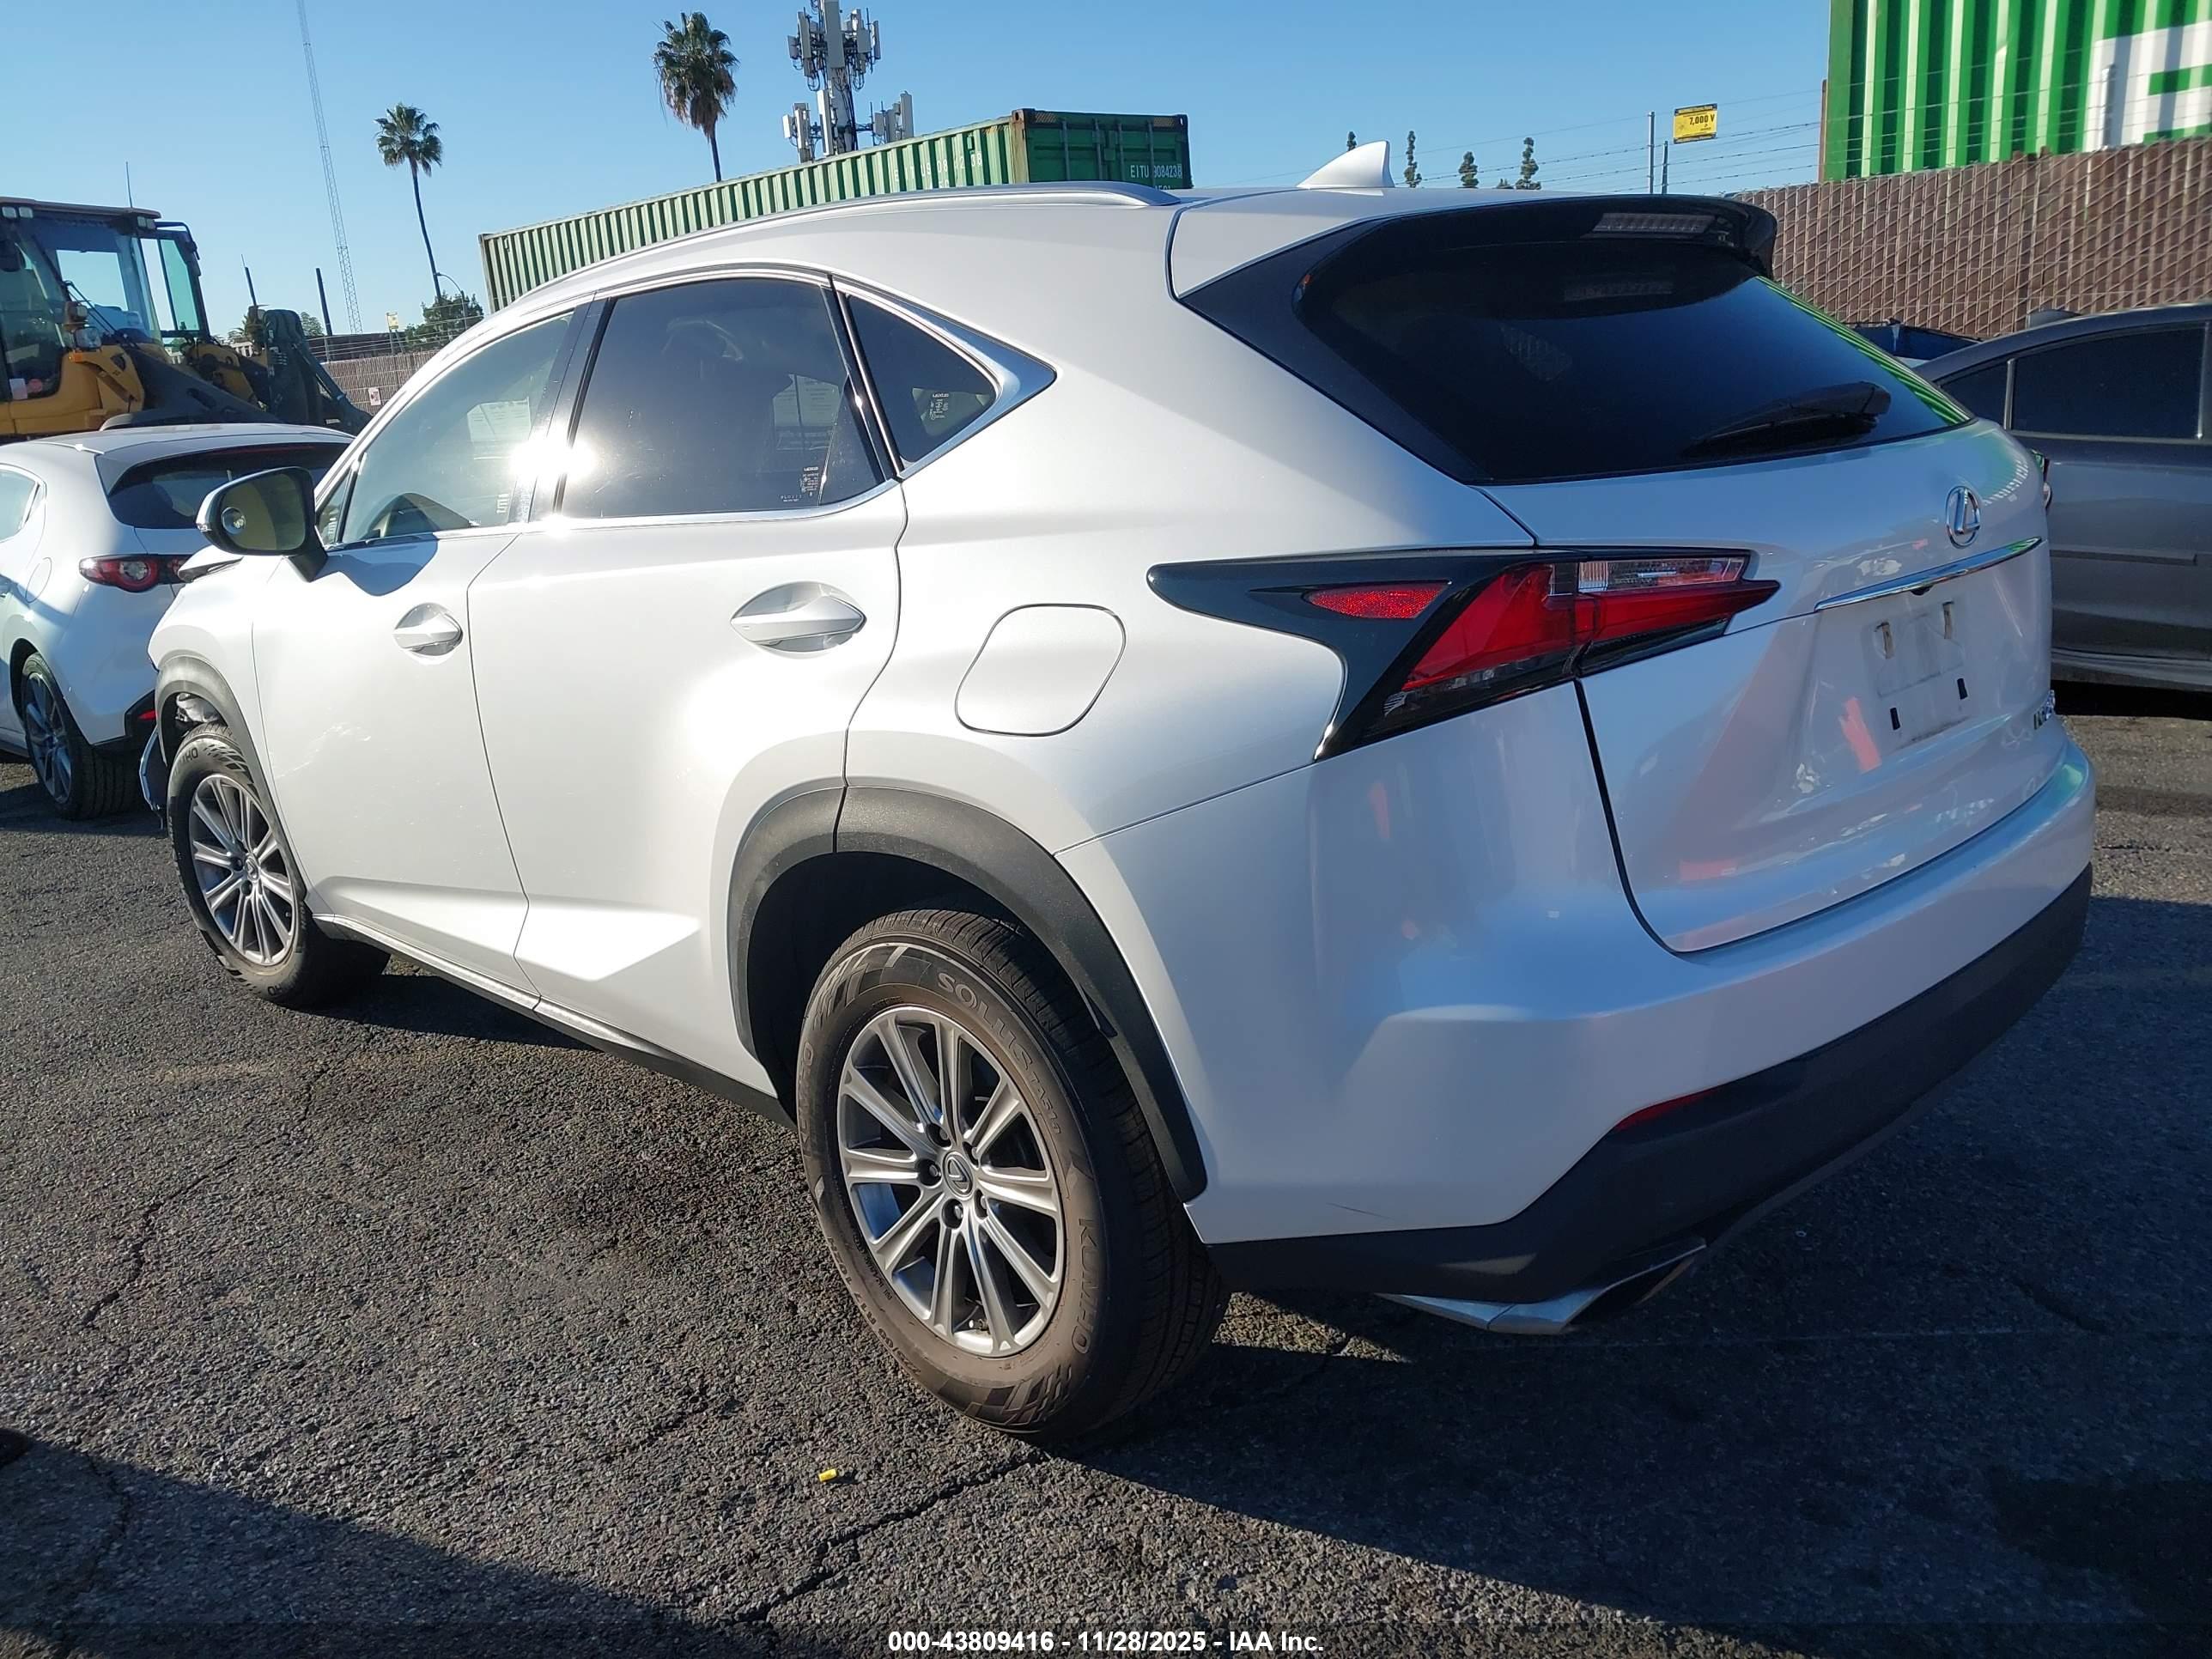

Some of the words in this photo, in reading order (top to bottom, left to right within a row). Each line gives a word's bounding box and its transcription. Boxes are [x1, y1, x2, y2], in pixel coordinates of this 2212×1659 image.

[1689, 114, 1709, 126] 7,000
[1710, 113, 1716, 123] V
[1071, 1218, 1100, 1355] KUMHO
